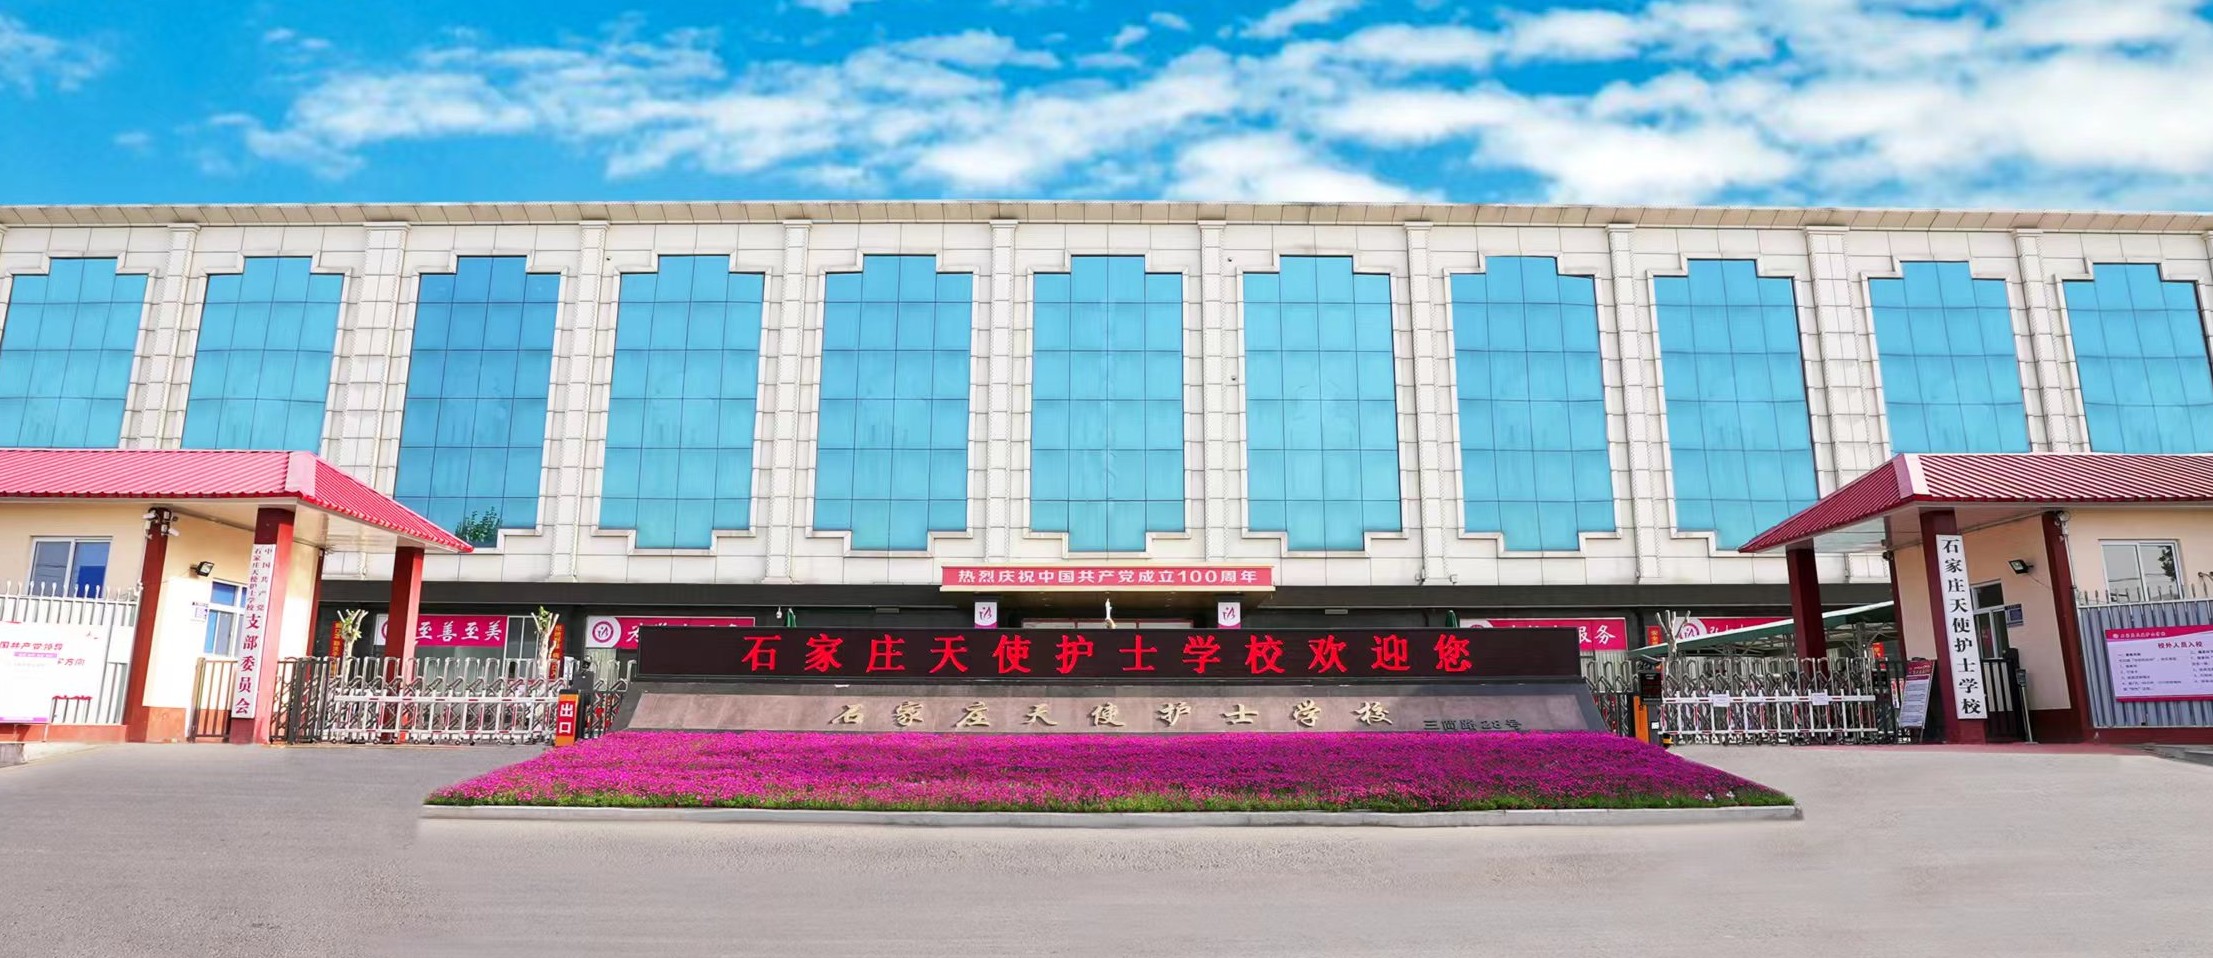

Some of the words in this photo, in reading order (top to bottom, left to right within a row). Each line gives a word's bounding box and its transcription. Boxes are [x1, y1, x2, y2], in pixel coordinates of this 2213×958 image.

[256, 548, 273, 611] 中国共产党
[957, 569, 1258, 584] 热烈庆祝中国共产党成立100周年
[415, 620, 502, 642] 至善至美
[1941, 537, 1982, 715] 石家庄天使护士学校
[235, 613, 261, 715] 支部委员会
[740, 632, 1473, 675] 石家庄天使护士学校欢迎您
[558, 702, 574, 734] 出口
[828, 700, 1394, 728] 石家庄天使护士学校
